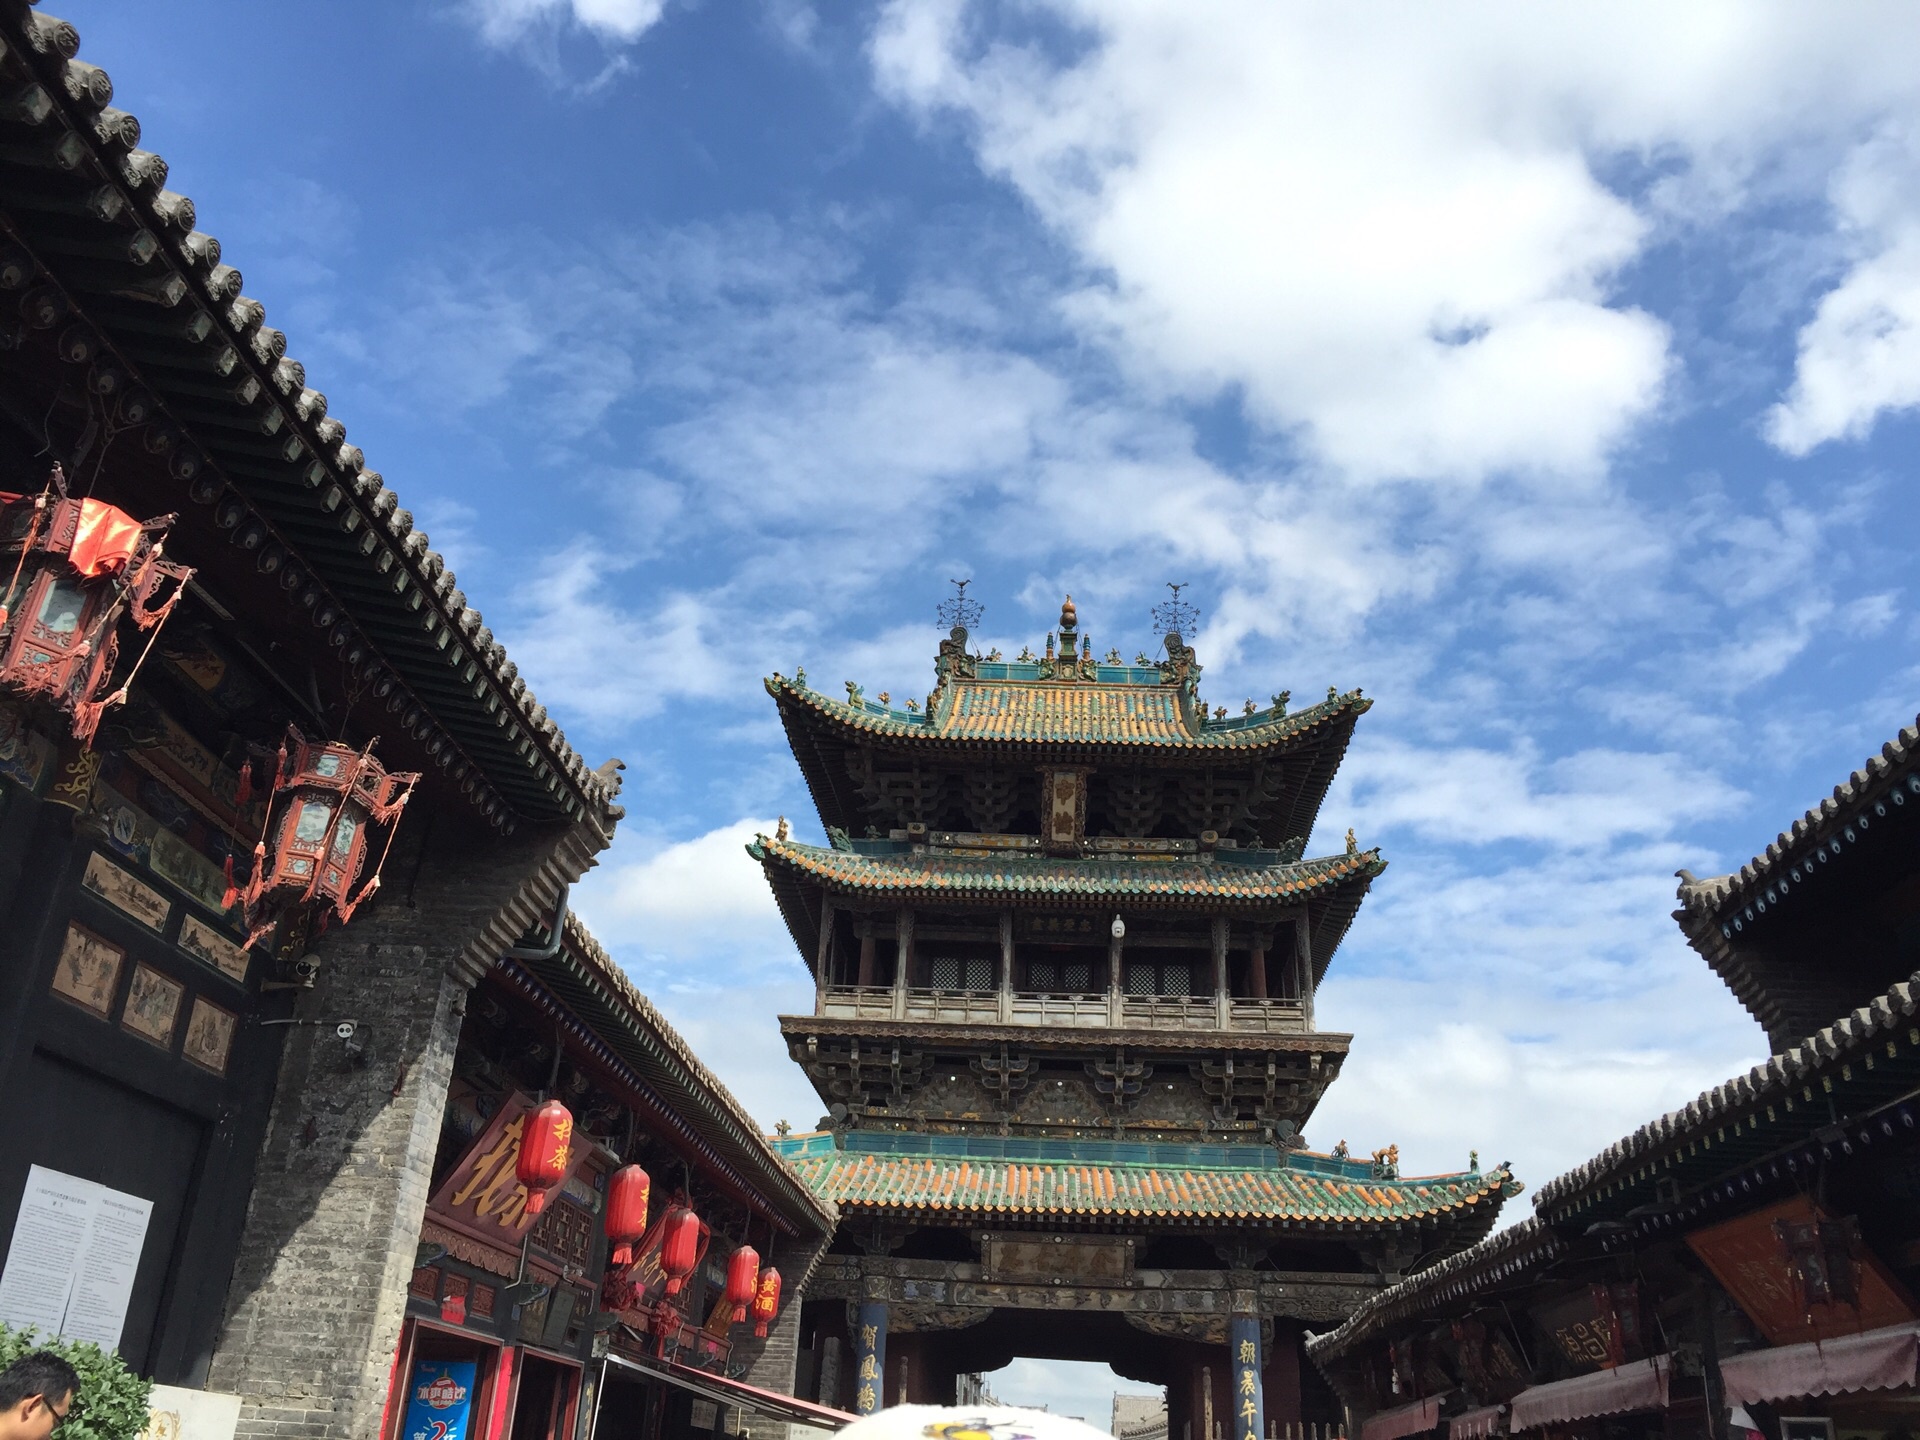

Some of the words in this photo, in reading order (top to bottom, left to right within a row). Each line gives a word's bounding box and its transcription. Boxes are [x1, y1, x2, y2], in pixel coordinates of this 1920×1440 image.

[755, 1279, 778, 1312] 黄酒
[857, 1323, 878, 1415] 賀鳳橋
